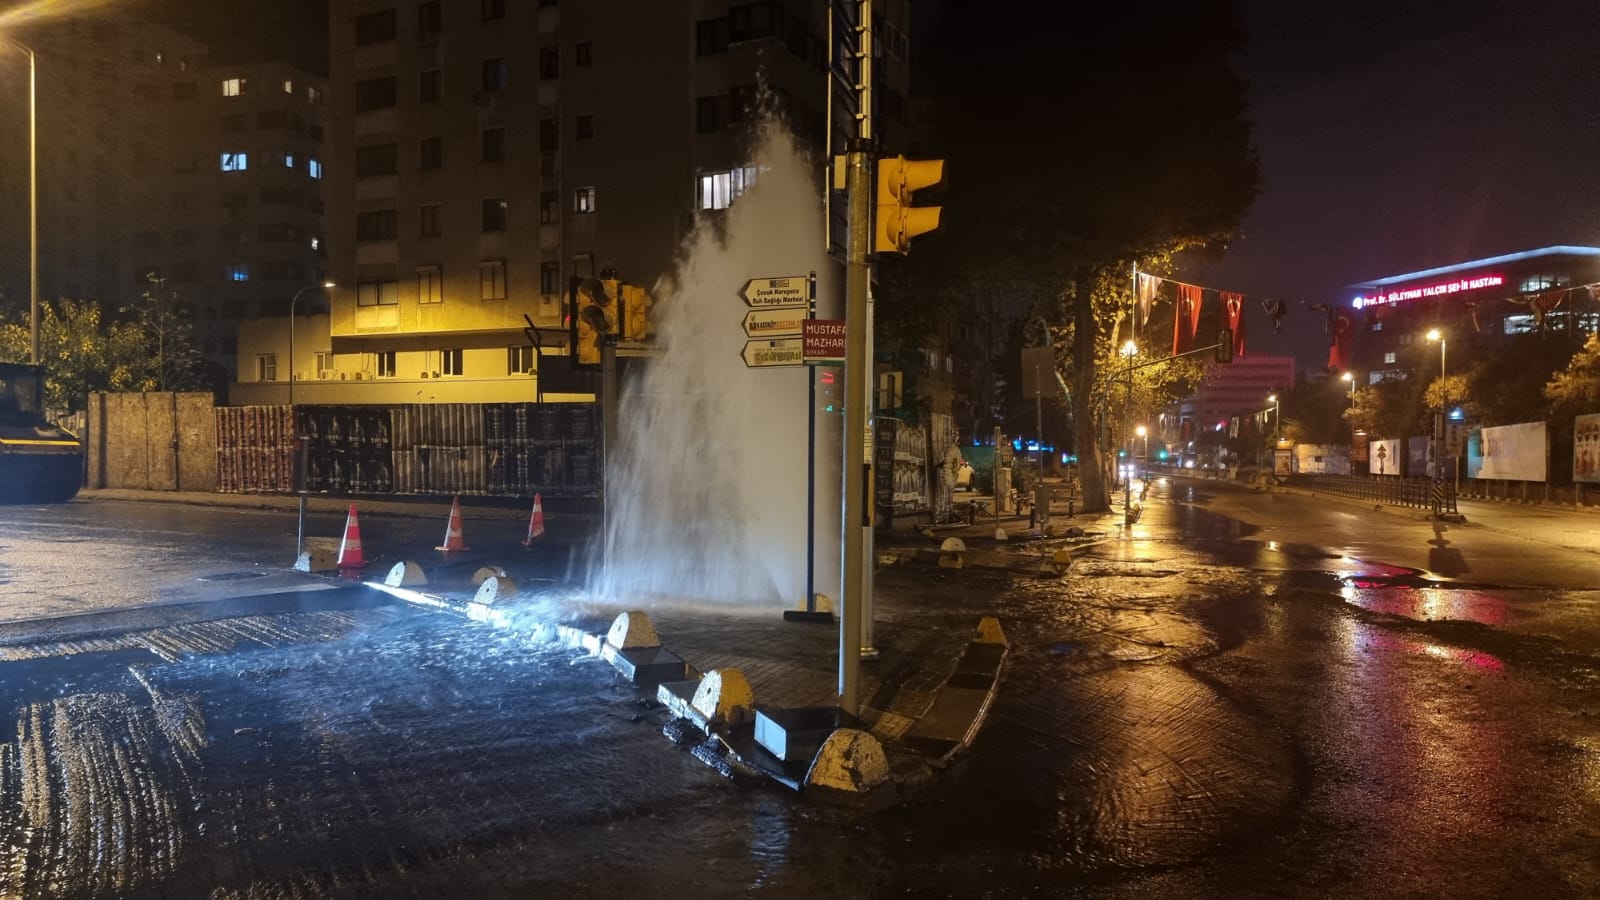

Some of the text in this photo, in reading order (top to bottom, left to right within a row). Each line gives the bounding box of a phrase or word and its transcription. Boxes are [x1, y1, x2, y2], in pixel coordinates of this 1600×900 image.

[774, 288, 800, 296] Koruyucu
[1363, 297, 1378, 306] Prof.
[1378, 295, 1388, 304] Dr.
[1388, 289, 1422, 302] SÜLEYMAN
[1423, 285, 1447, 297] YALÇIN
[764, 297, 782, 305] Sağlığı
